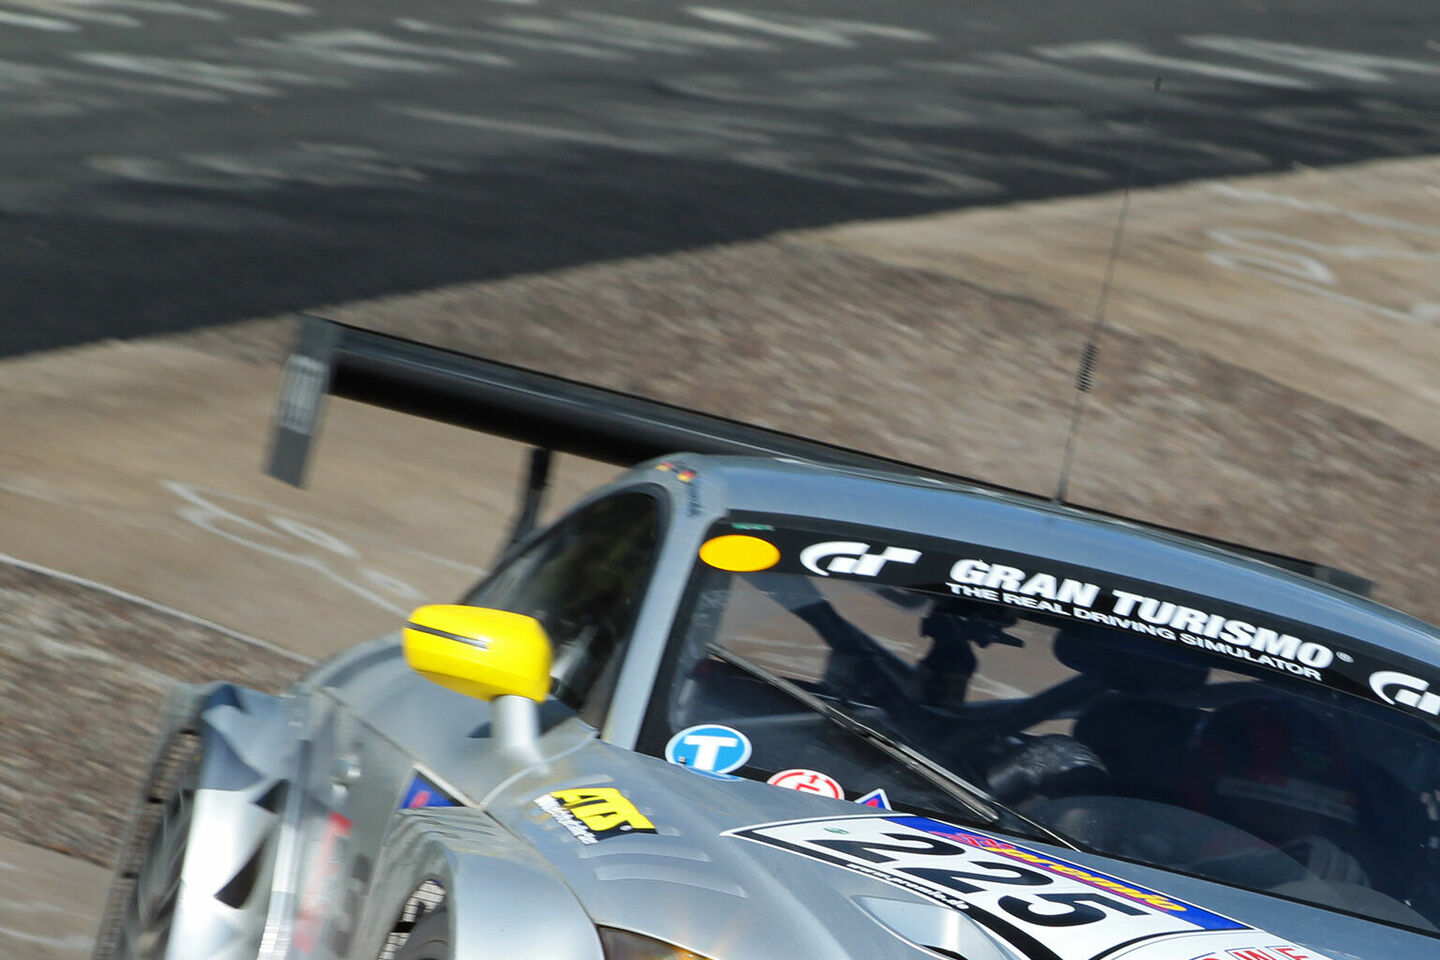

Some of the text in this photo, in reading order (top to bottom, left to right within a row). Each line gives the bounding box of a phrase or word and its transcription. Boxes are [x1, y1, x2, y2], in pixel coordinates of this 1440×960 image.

[946, 582, 1322, 682] THE REAL DRIVING SIMULATOR
[950, 558, 1334, 669] GRAN TURISMO
[550, 787, 656, 831] ATS
[808, 832, 1152, 928] 225
